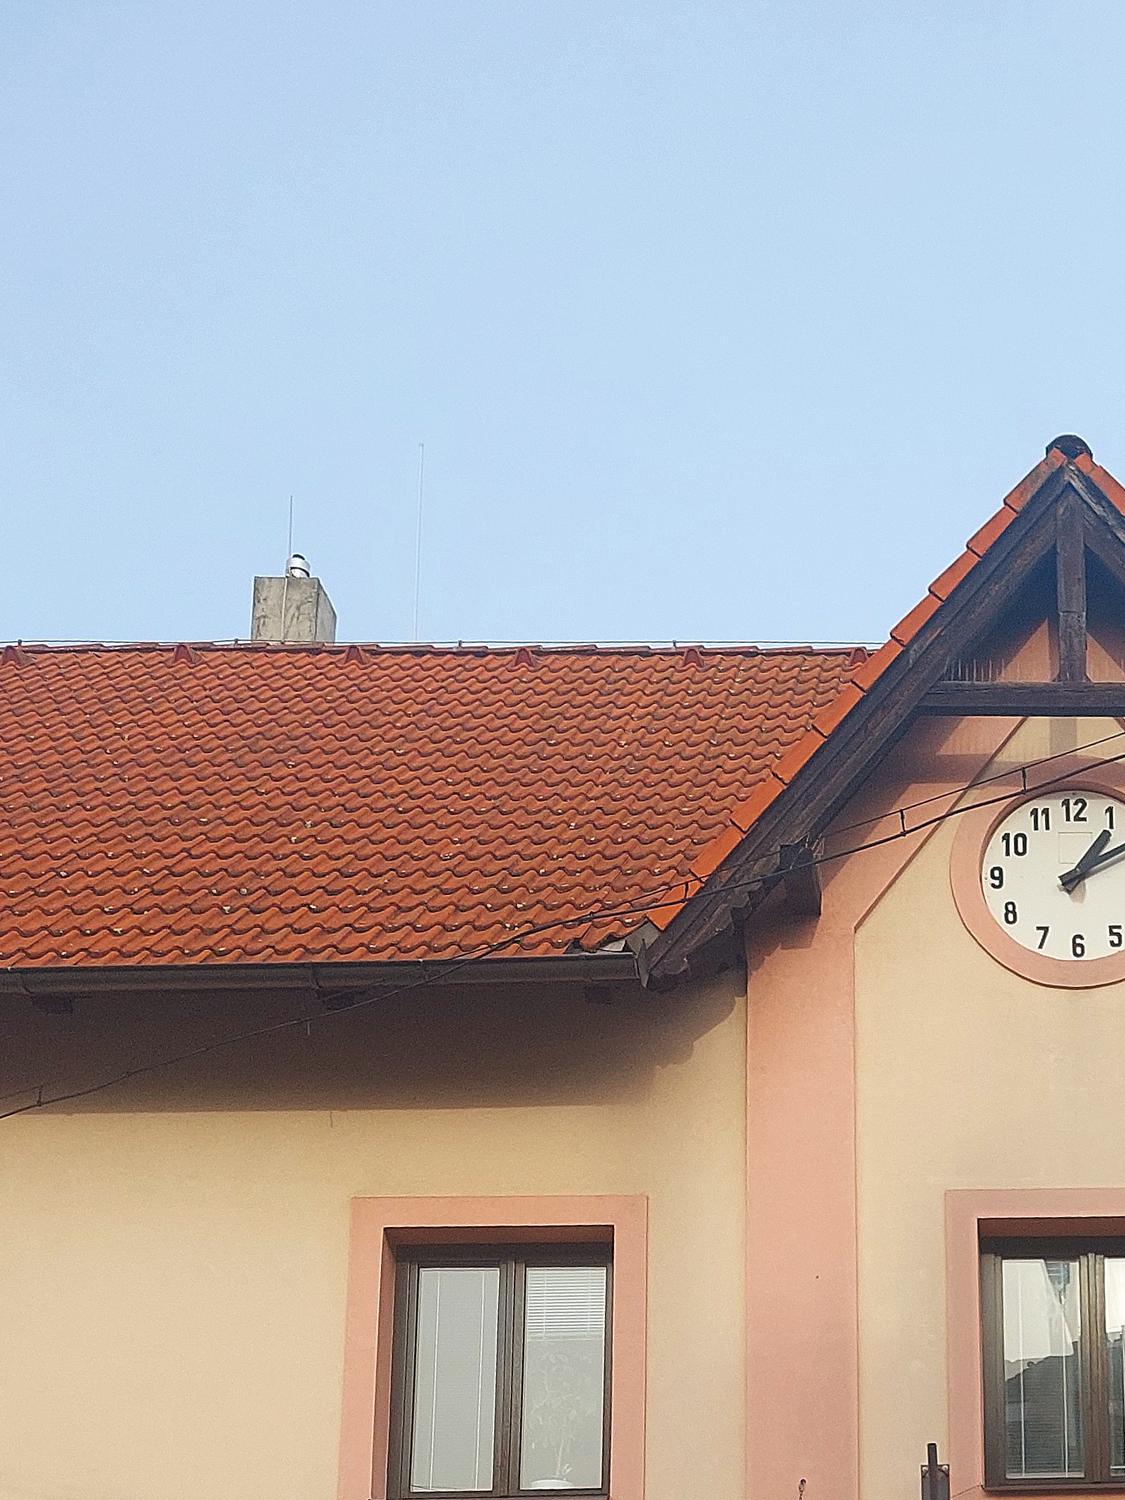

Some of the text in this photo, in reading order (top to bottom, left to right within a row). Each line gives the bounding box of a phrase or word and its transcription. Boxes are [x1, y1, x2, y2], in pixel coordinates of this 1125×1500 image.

[1030, 807, 1050, 831] 11
[1061, 797, 1087, 822] 12
[1105, 806, 1115, 830] 1
[1001, 832, 1028, 857] 10
[989, 866, 1004, 889] 9
[1004, 901, 1018, 925] 8
[1035, 926, 1050, 949] 7
[1071, 934, 1086, 958] 6
[1108, 925, 1122, 948] 5
